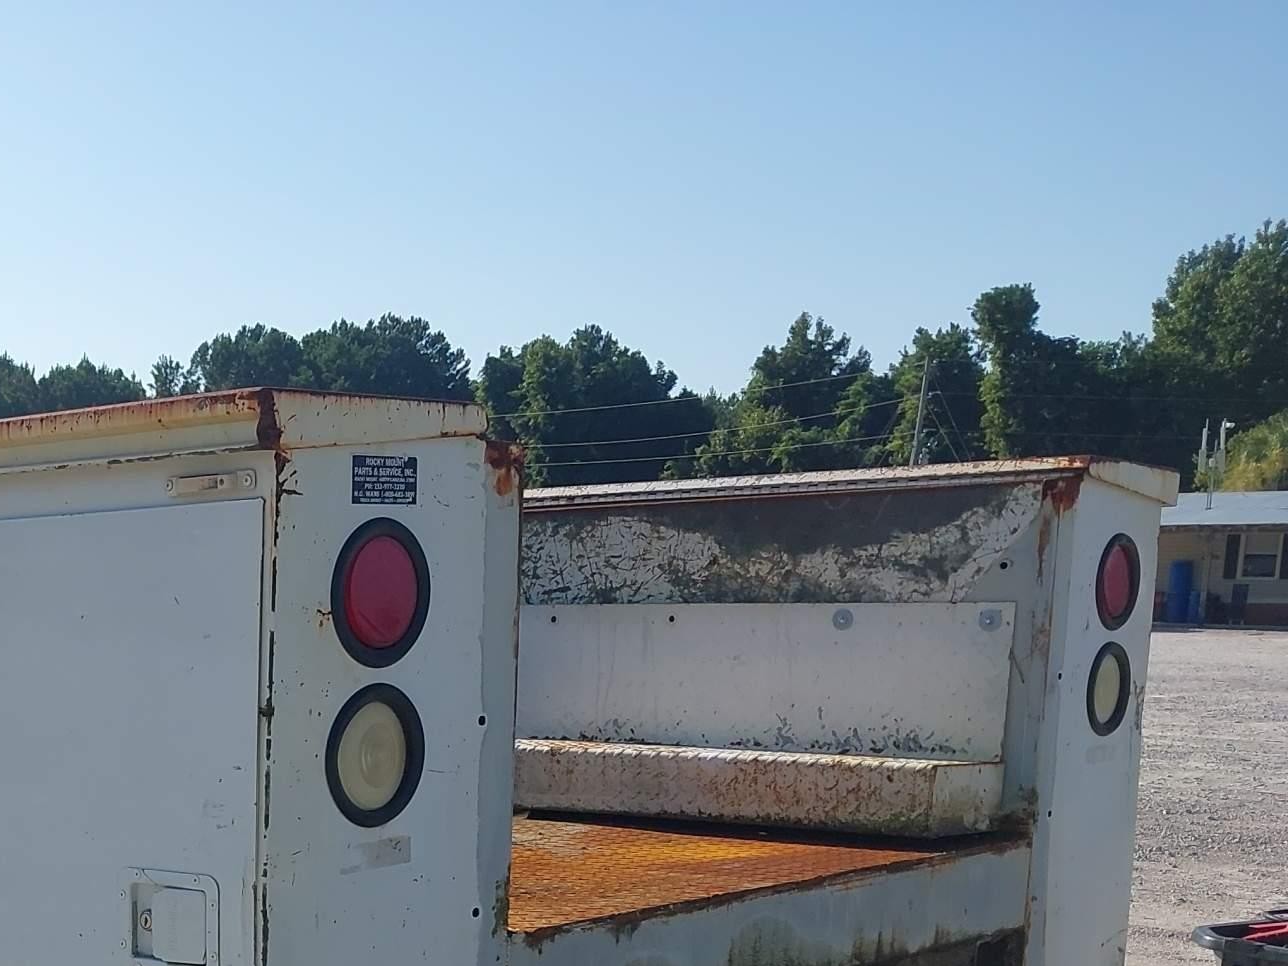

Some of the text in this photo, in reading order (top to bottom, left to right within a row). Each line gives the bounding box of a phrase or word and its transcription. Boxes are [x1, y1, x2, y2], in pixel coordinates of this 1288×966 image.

[365, 458, 405, 467] ROCKY MOUNT
[354, 467, 372, 476] PARTS
[373, 467, 378, 476] &
